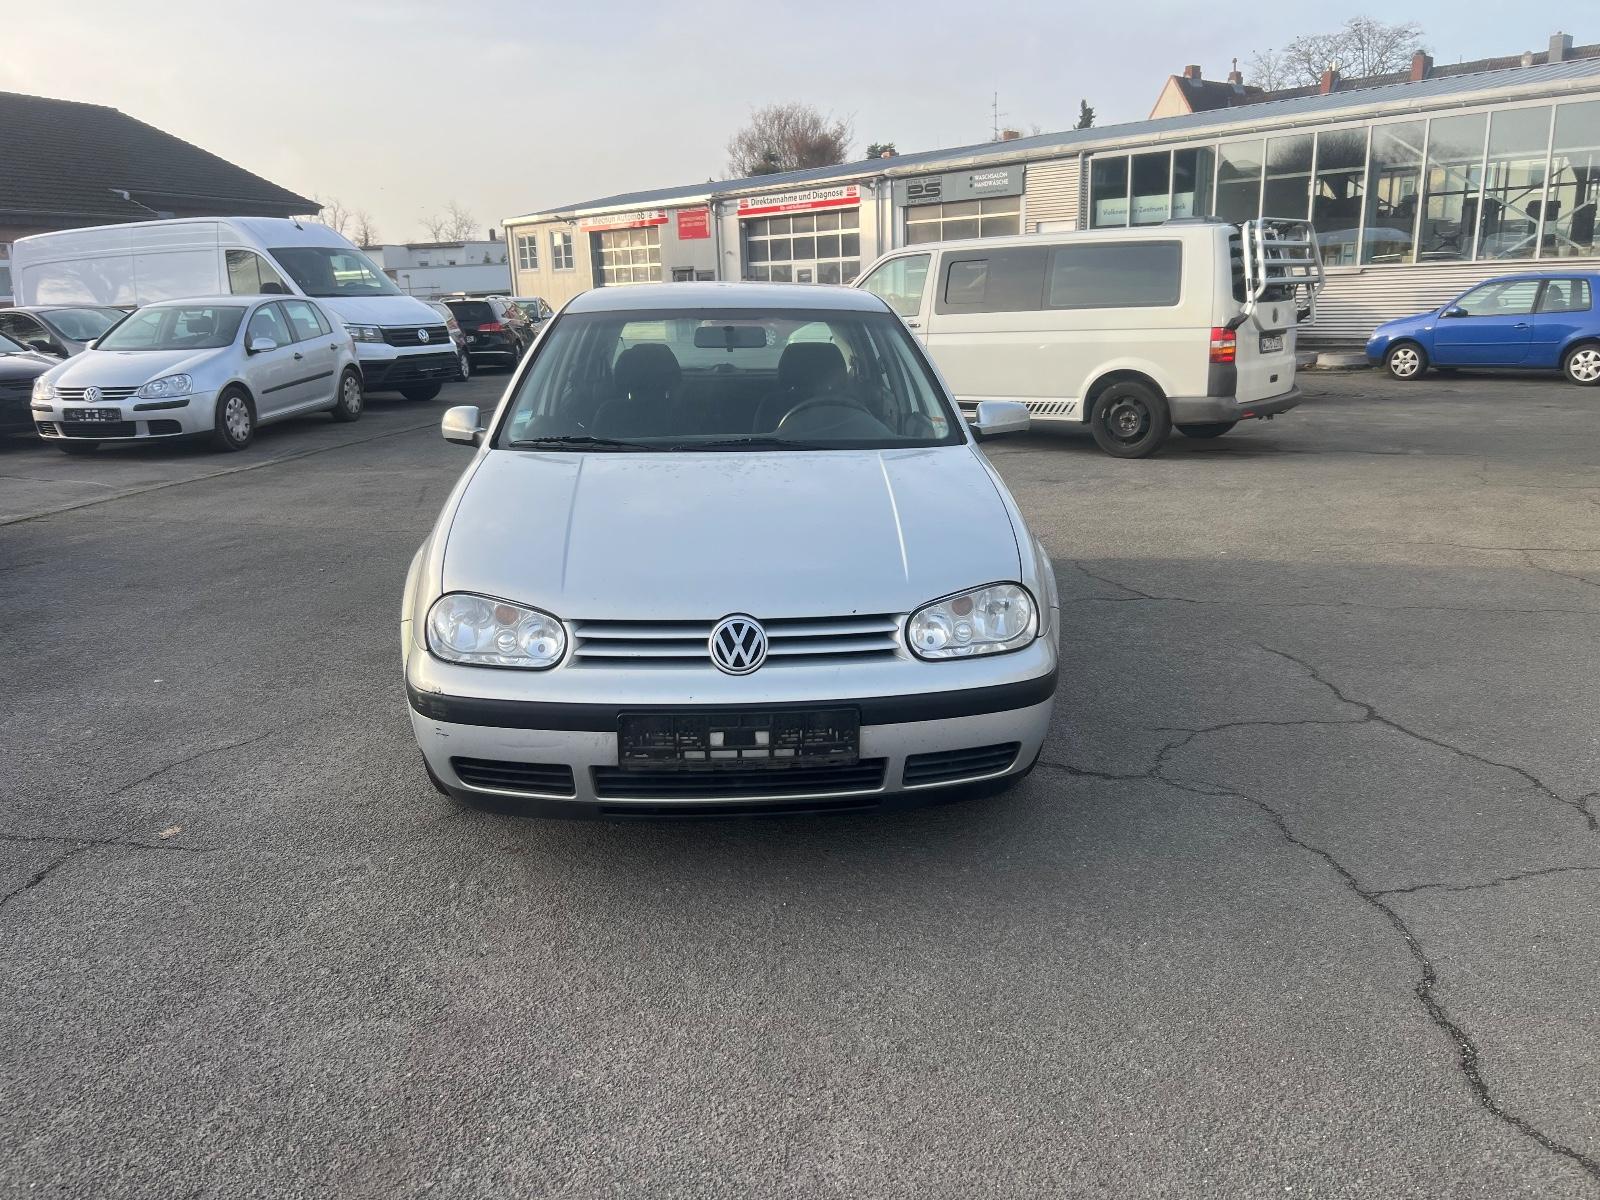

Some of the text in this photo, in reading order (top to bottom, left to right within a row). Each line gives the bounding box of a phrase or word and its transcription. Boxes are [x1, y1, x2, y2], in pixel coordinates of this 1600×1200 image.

[750, 195, 798, 207] Direktannahme
[798, 194, 812, 202] und
[812, 189, 843, 201] Diagnose
[712, 618, 765, 671] VW
